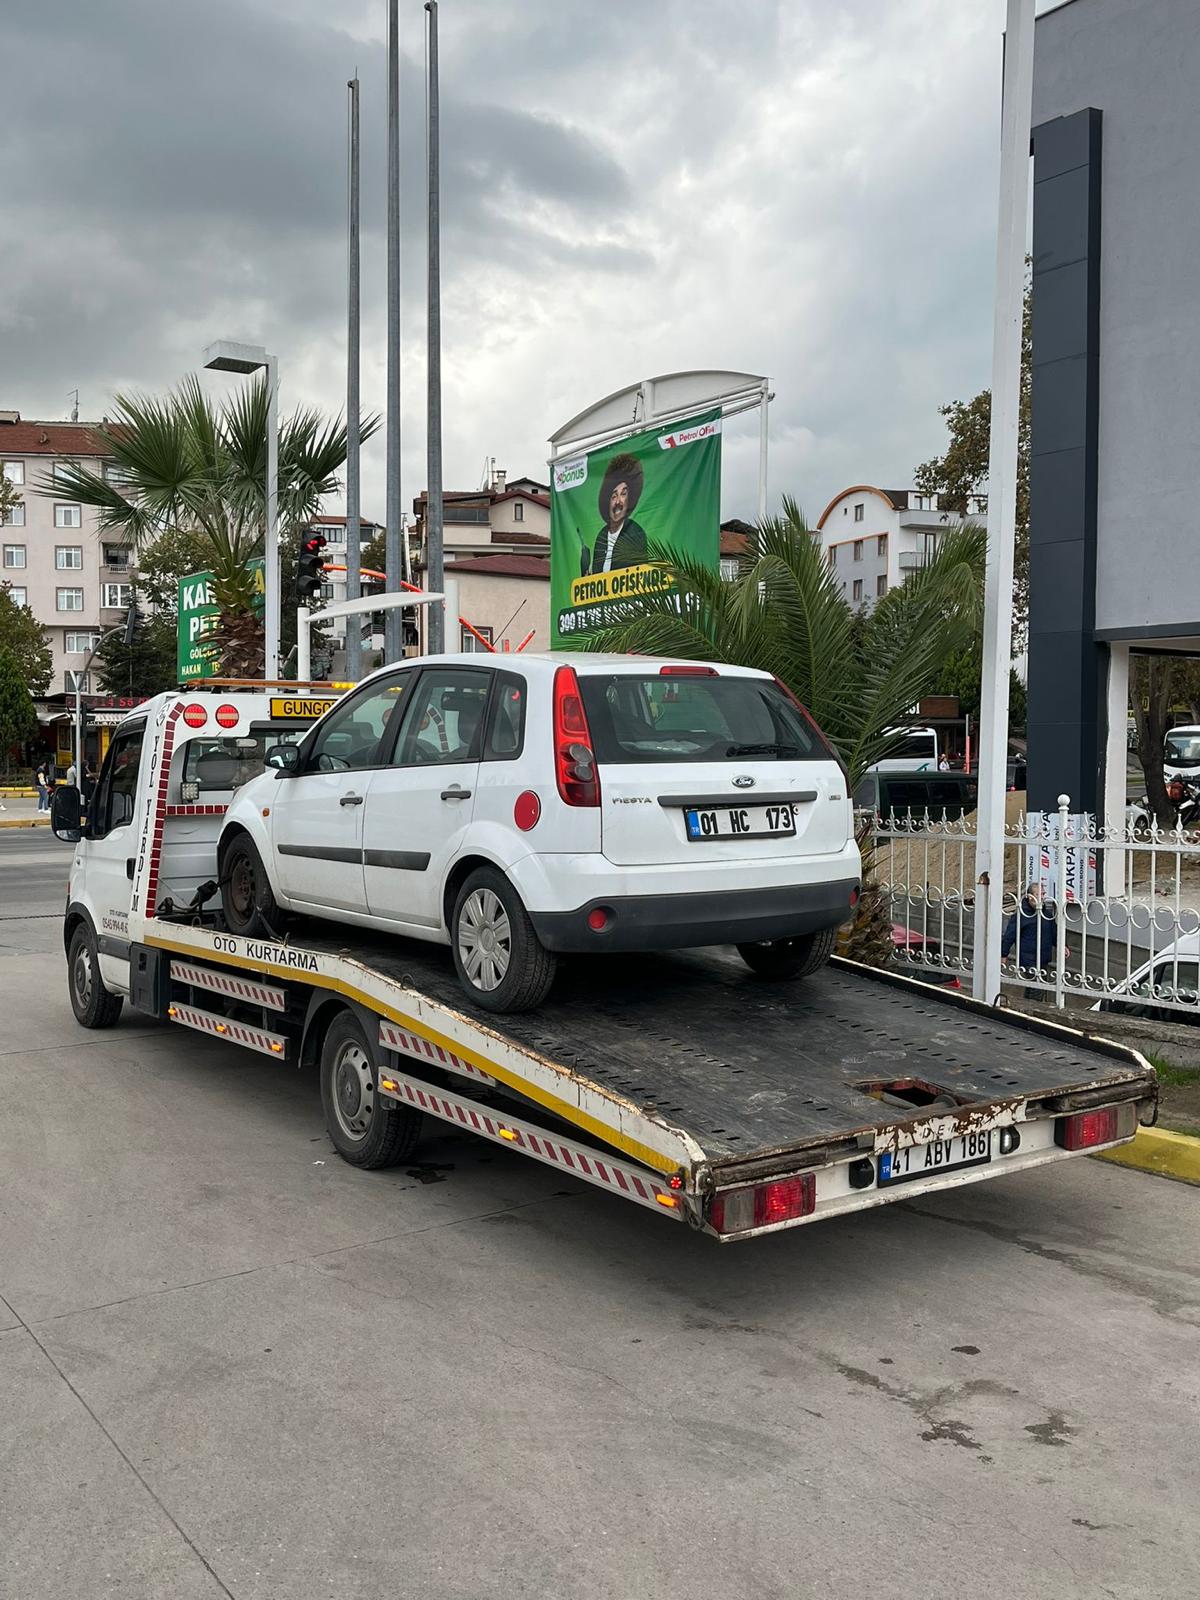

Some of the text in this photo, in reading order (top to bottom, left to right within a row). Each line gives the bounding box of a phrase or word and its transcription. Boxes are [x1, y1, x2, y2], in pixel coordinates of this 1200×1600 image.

[574, 580, 608, 602] PETROL
[181, 663, 201, 676] HAKAN
[131, 736, 160, 912] YOL YARDIM
[701, 810, 719, 835] 01
[730, 810, 750, 833] HC
[766, 807, 791, 831] 173
[214, 937, 319, 972] OTO KURTARMA
[892, 1149, 910, 1174] 41
[924, 1140, 952, 1167] ABV
[961, 1134, 986, 1159] 186
